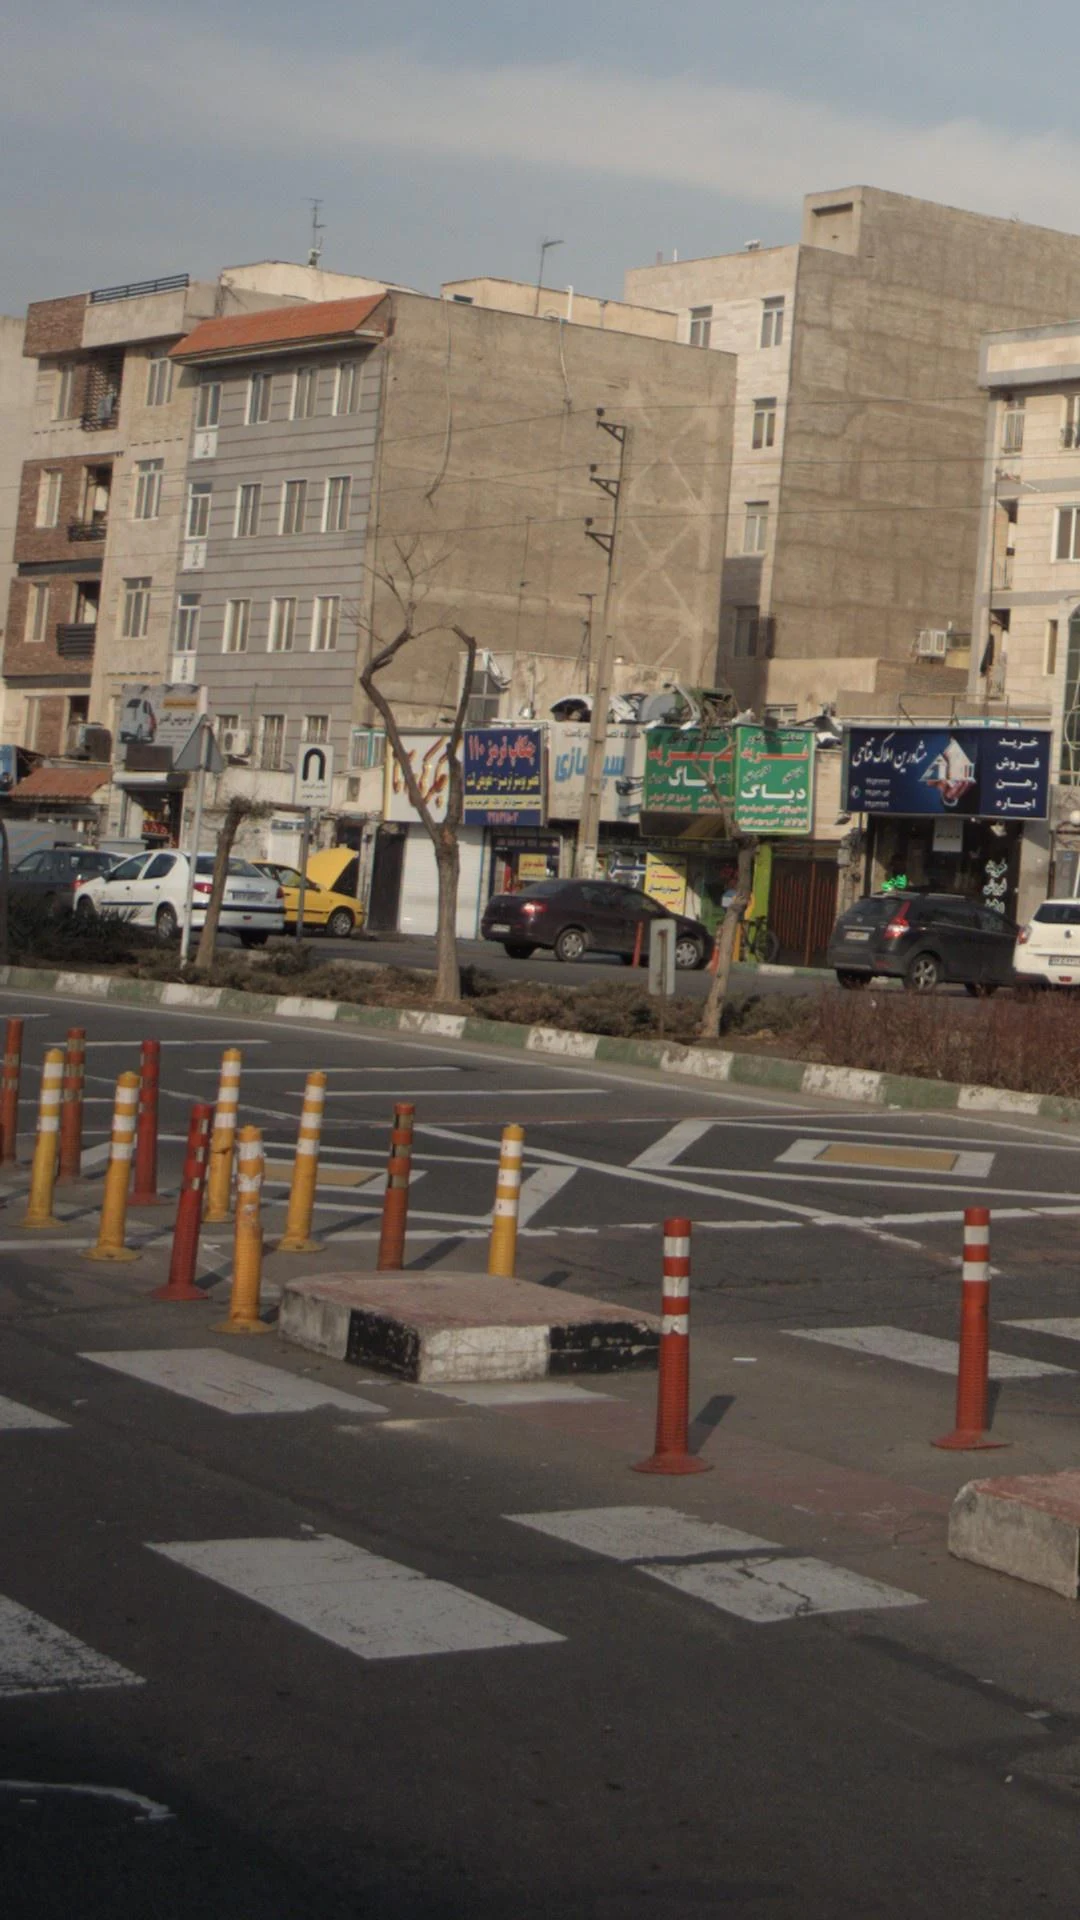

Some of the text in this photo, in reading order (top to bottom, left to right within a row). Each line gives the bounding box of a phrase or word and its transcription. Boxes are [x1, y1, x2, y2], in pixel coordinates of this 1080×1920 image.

[998, 736, 1039, 750] خرید
[995, 756, 1040, 771] فروش
[995, 778, 1038, 791] رهن
[995, 797, 1036, 812] اجاره
